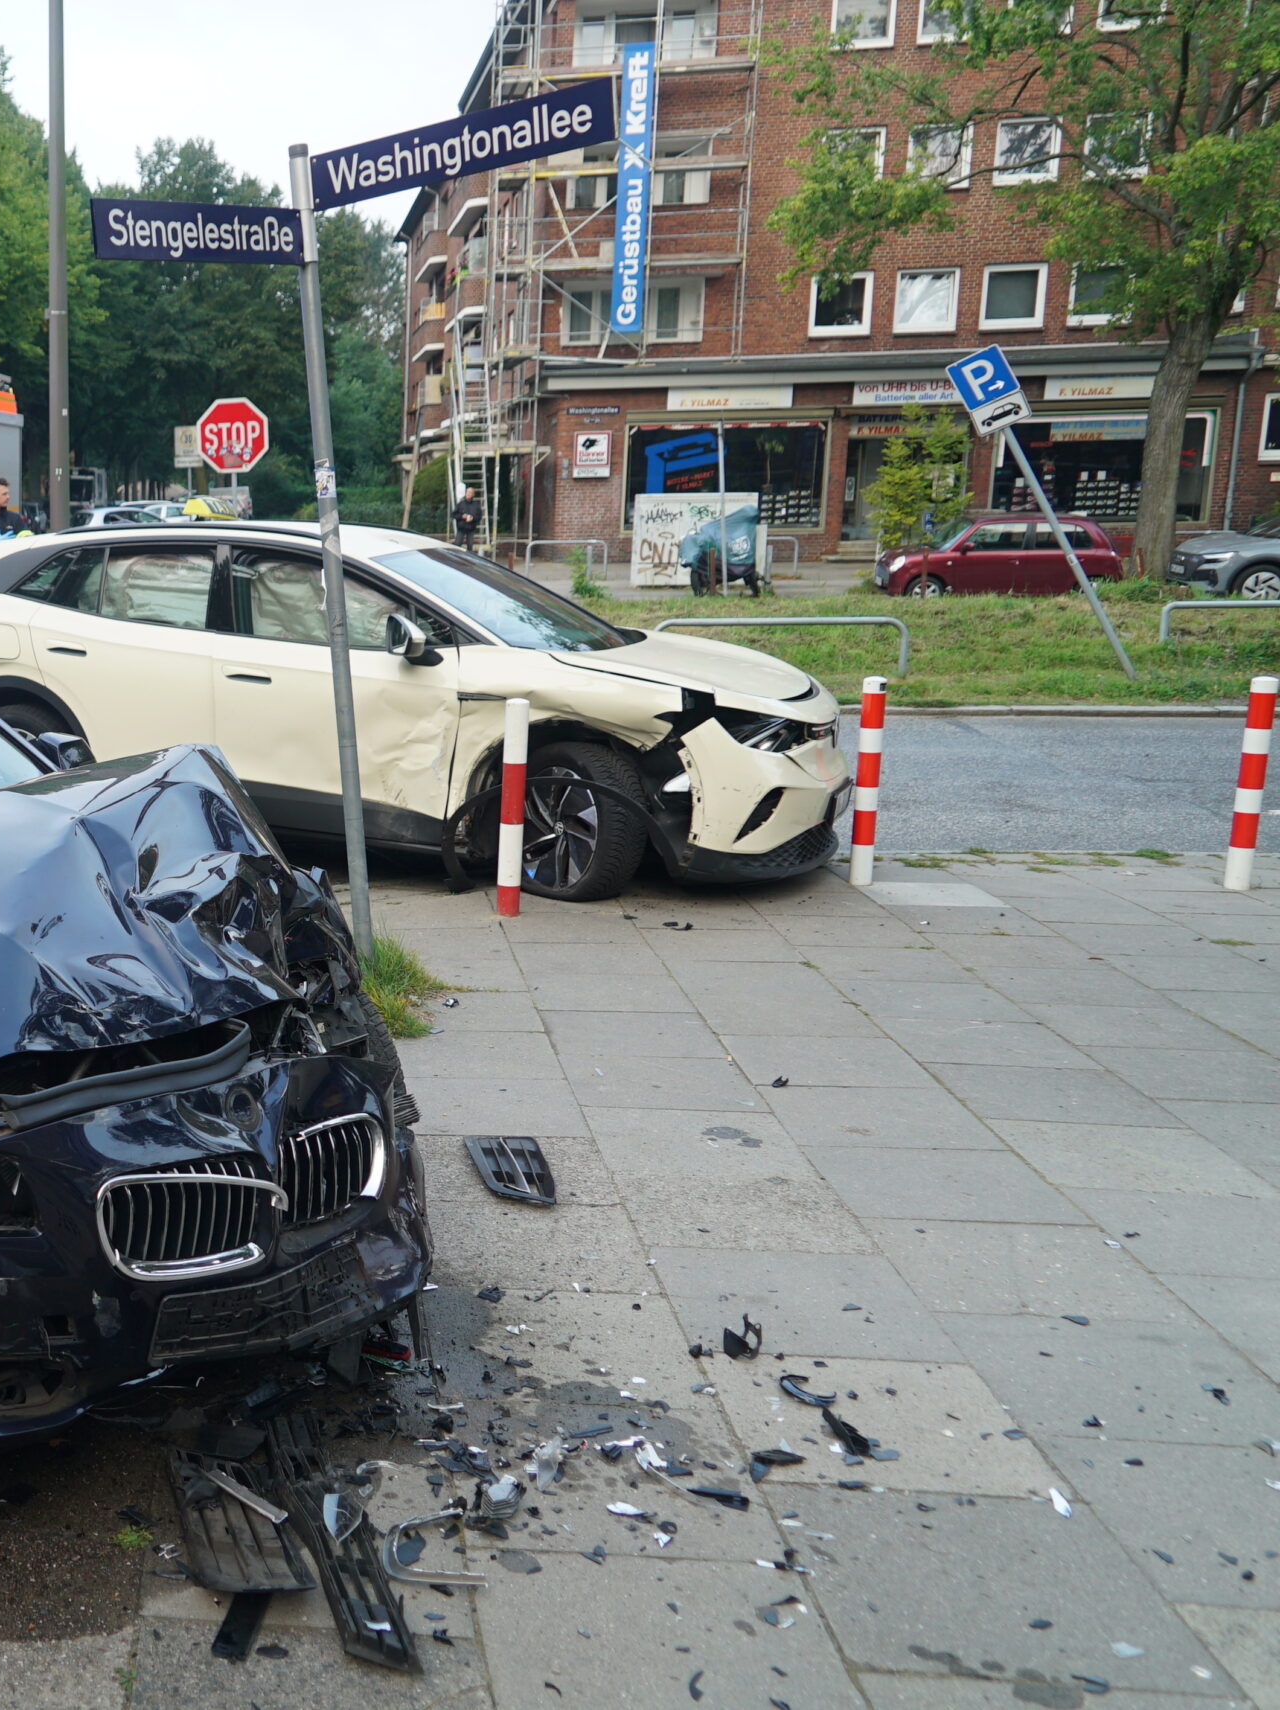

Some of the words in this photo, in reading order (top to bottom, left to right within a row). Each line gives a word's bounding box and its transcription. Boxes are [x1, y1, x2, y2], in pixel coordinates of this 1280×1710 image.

[625, 50, 649, 135] Kreft
[326, 103, 593, 196] Washingtonallee
[108, 207, 294, 258] Stengelestraße
[616, 178, 643, 326] Gerüstbau
[858, 385, 879, 393] von
[882, 382, 907, 392] UHR
[910, 381, 927, 392] bis
[961, 359, 995, 401] P
[691, 398, 730, 407] YILMAZ
[874, 393, 916, 403] Batterien
[918, 392, 938, 401] aller
[940, 391, 954, 400] Art
[1071, 387, 1114, 396] YILMAZ
[568, 406, 619, 415] Washingtonallee
[205, 420, 260, 452] STOP
[1062, 432, 1104, 441] YILMAZ
